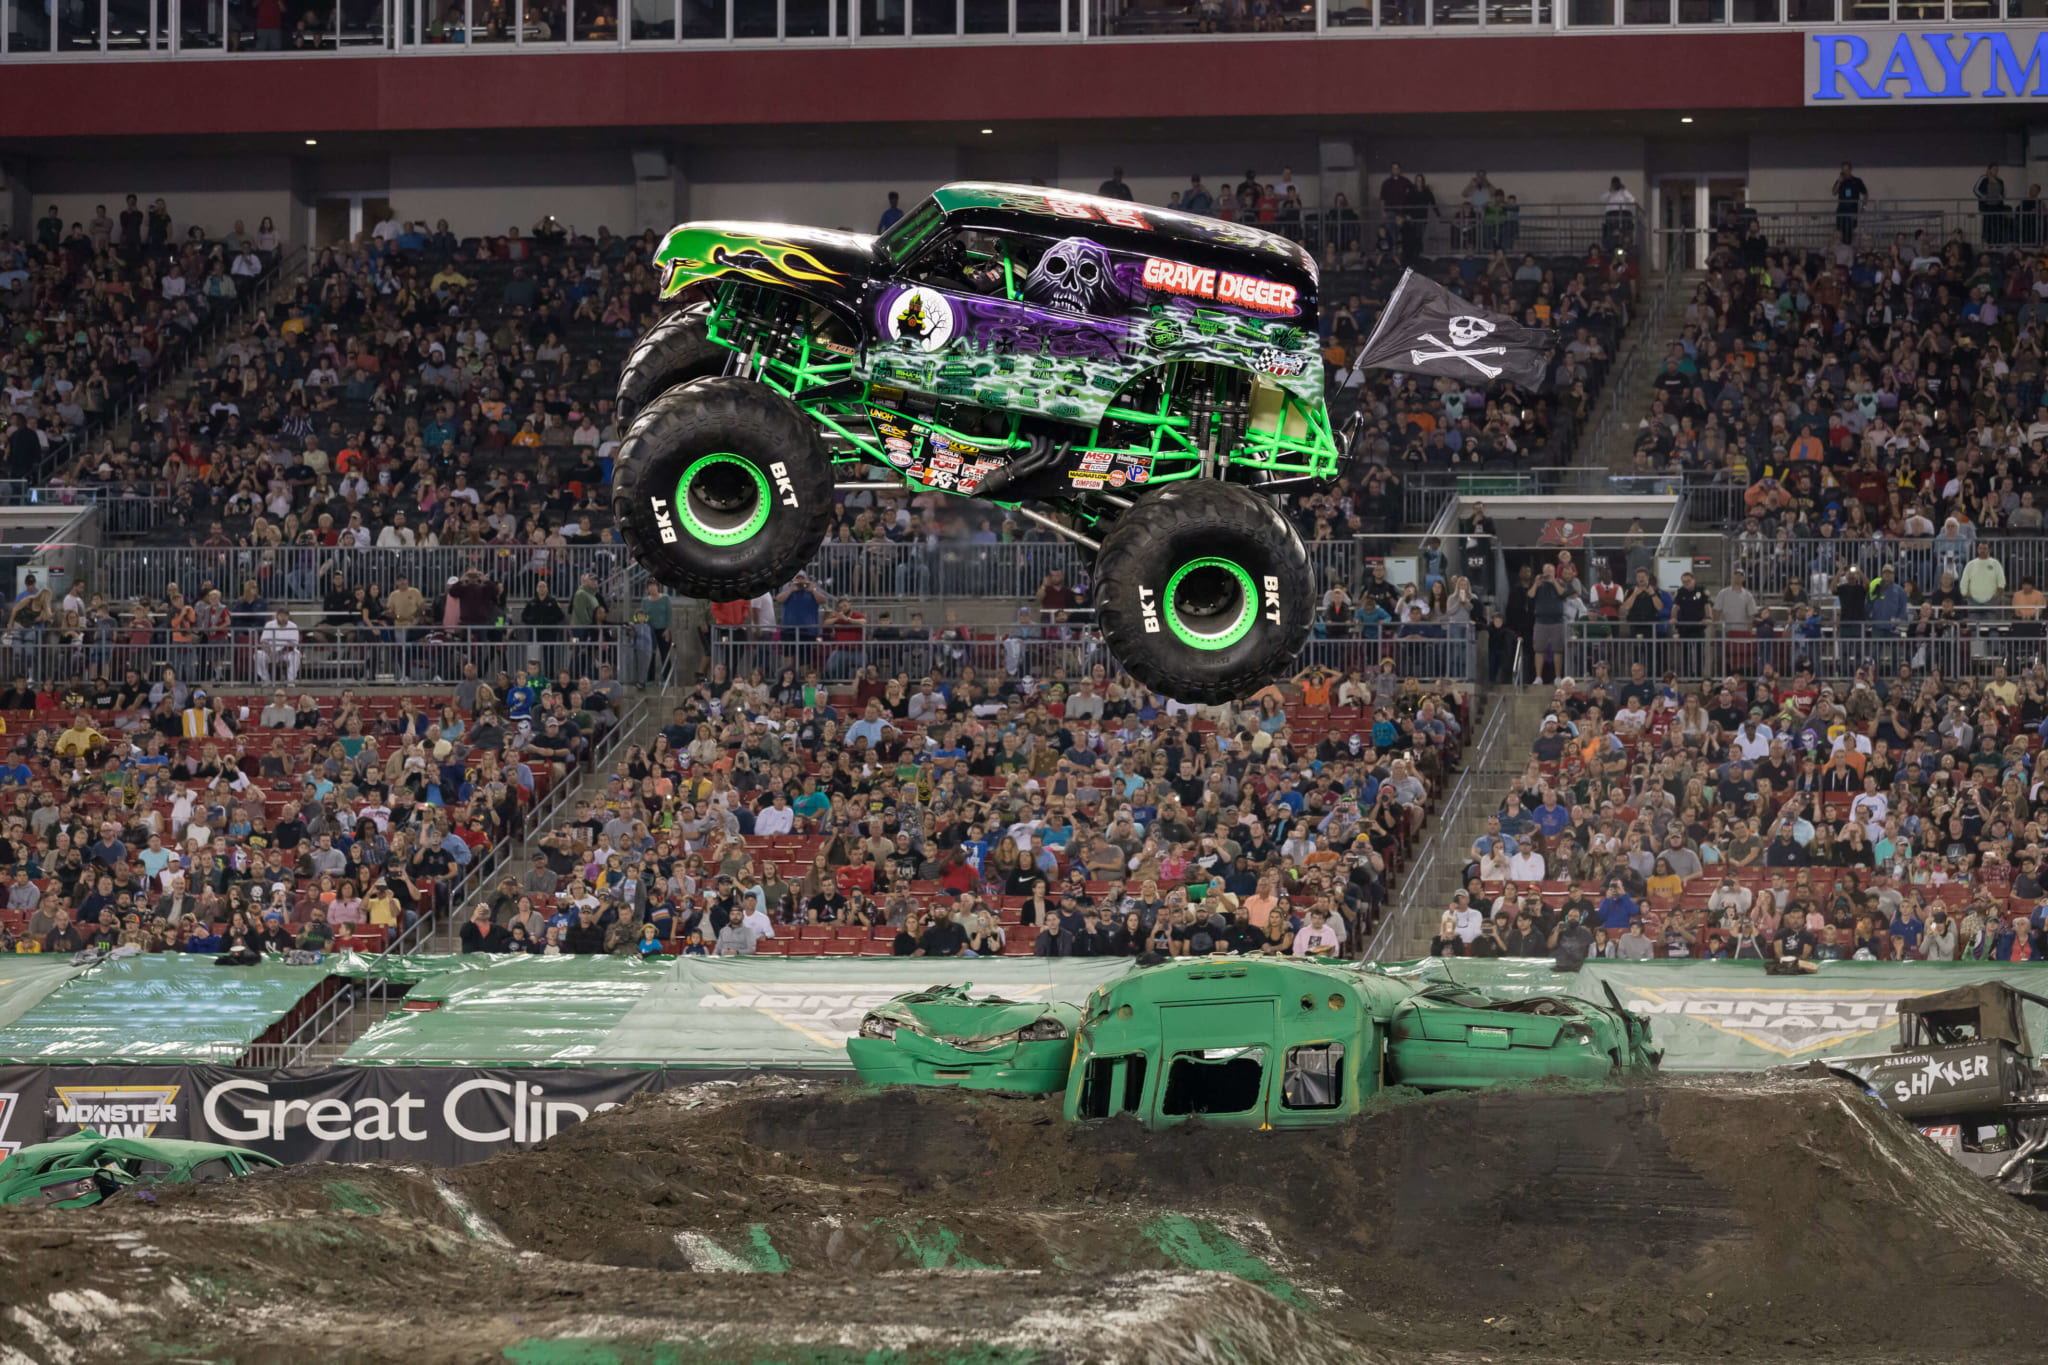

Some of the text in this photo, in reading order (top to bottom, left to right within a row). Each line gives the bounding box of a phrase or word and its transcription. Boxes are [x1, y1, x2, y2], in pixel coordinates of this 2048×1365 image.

[1812, 32, 2048, 98] RAYM
[1142, 257, 1298, 314] GRAVE DIGGER
[870, 408, 894, 421] UNOH
[1085, 452, 1112, 461] MSD
[1069, 472, 1108, 480] MAGNAFLOW
[1128, 466, 1143, 481] VP
[770, 461, 799, 508] BKT
[1075, 479, 1100, 488] SIMPSON
[651, 496, 678, 544] BKT
[1264, 575, 1281, 625] BKT
[1138, 585, 1160, 633] BKT
[1626, 1001, 1898, 1016] MONST
[1720, 1016, 1879, 1028] JAM
[1884, 1055, 1930, 1067] SAIGON
[56, 1104, 177, 1123] MONSTER
[203, 1079, 625, 1143] Great Clip
